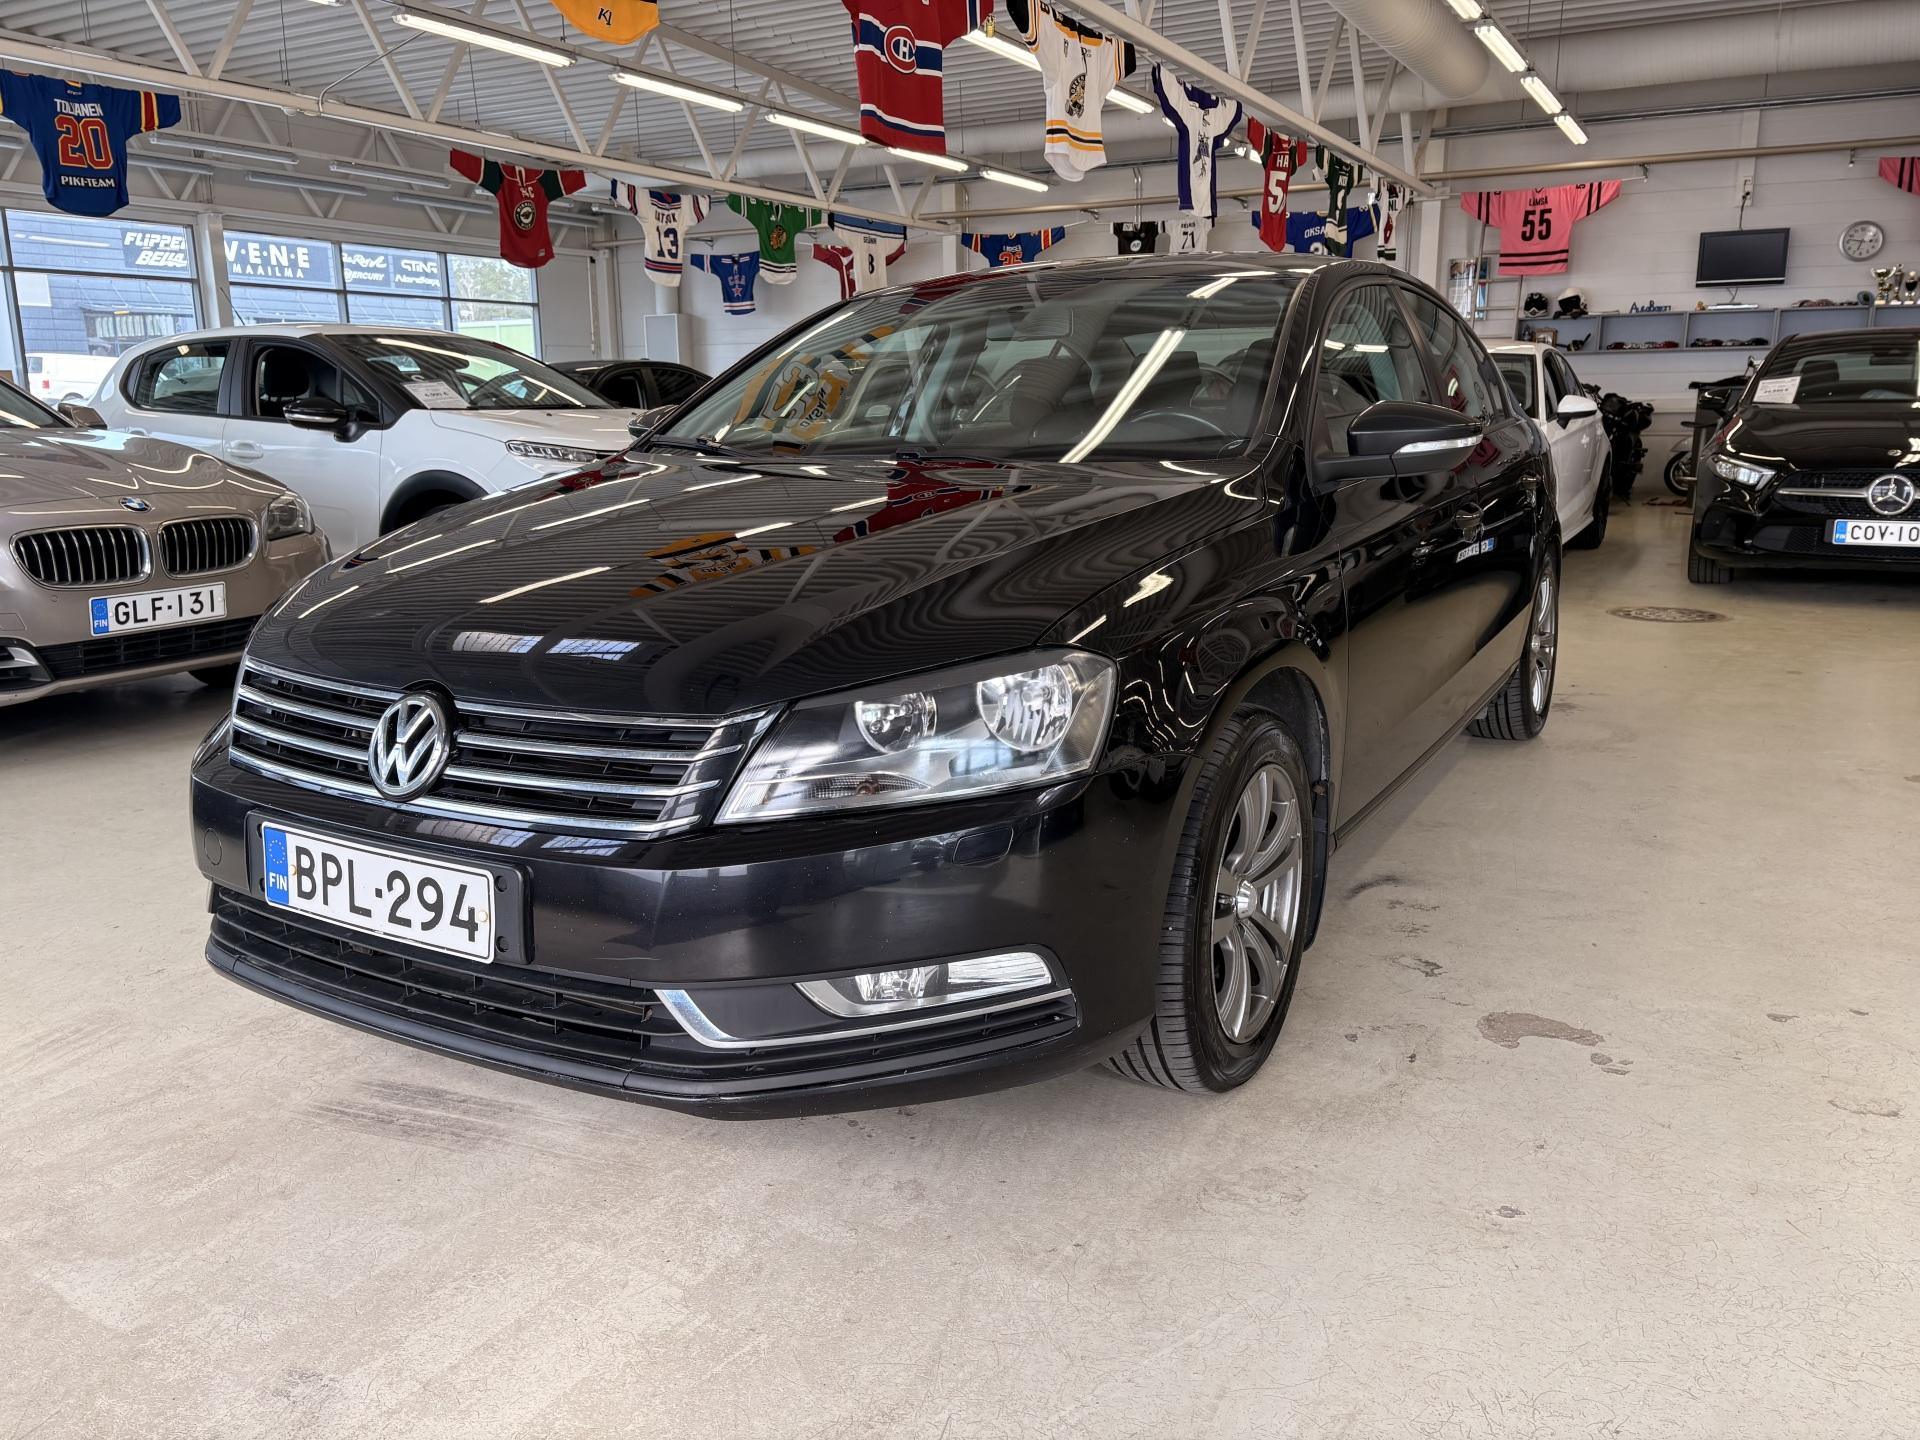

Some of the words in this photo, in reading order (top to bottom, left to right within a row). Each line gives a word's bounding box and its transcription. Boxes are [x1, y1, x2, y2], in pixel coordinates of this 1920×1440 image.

[54, 114, 114, 170] 20
[60, 175, 116, 188] PIKI-TEAM
[1267, 170, 1287, 214] 5
[1182, 231, 1195, 249] 71
[1521, 208, 1552, 241] 55
[656, 225, 679, 259] 13
[233, 263, 304, 279] MAAILMA
[94, 619, 108, 628] FIN
[114, 590, 215, 625] GLF-131
[269, 872, 287, 892] FIN
[295, 845, 479, 943] BPL-294
